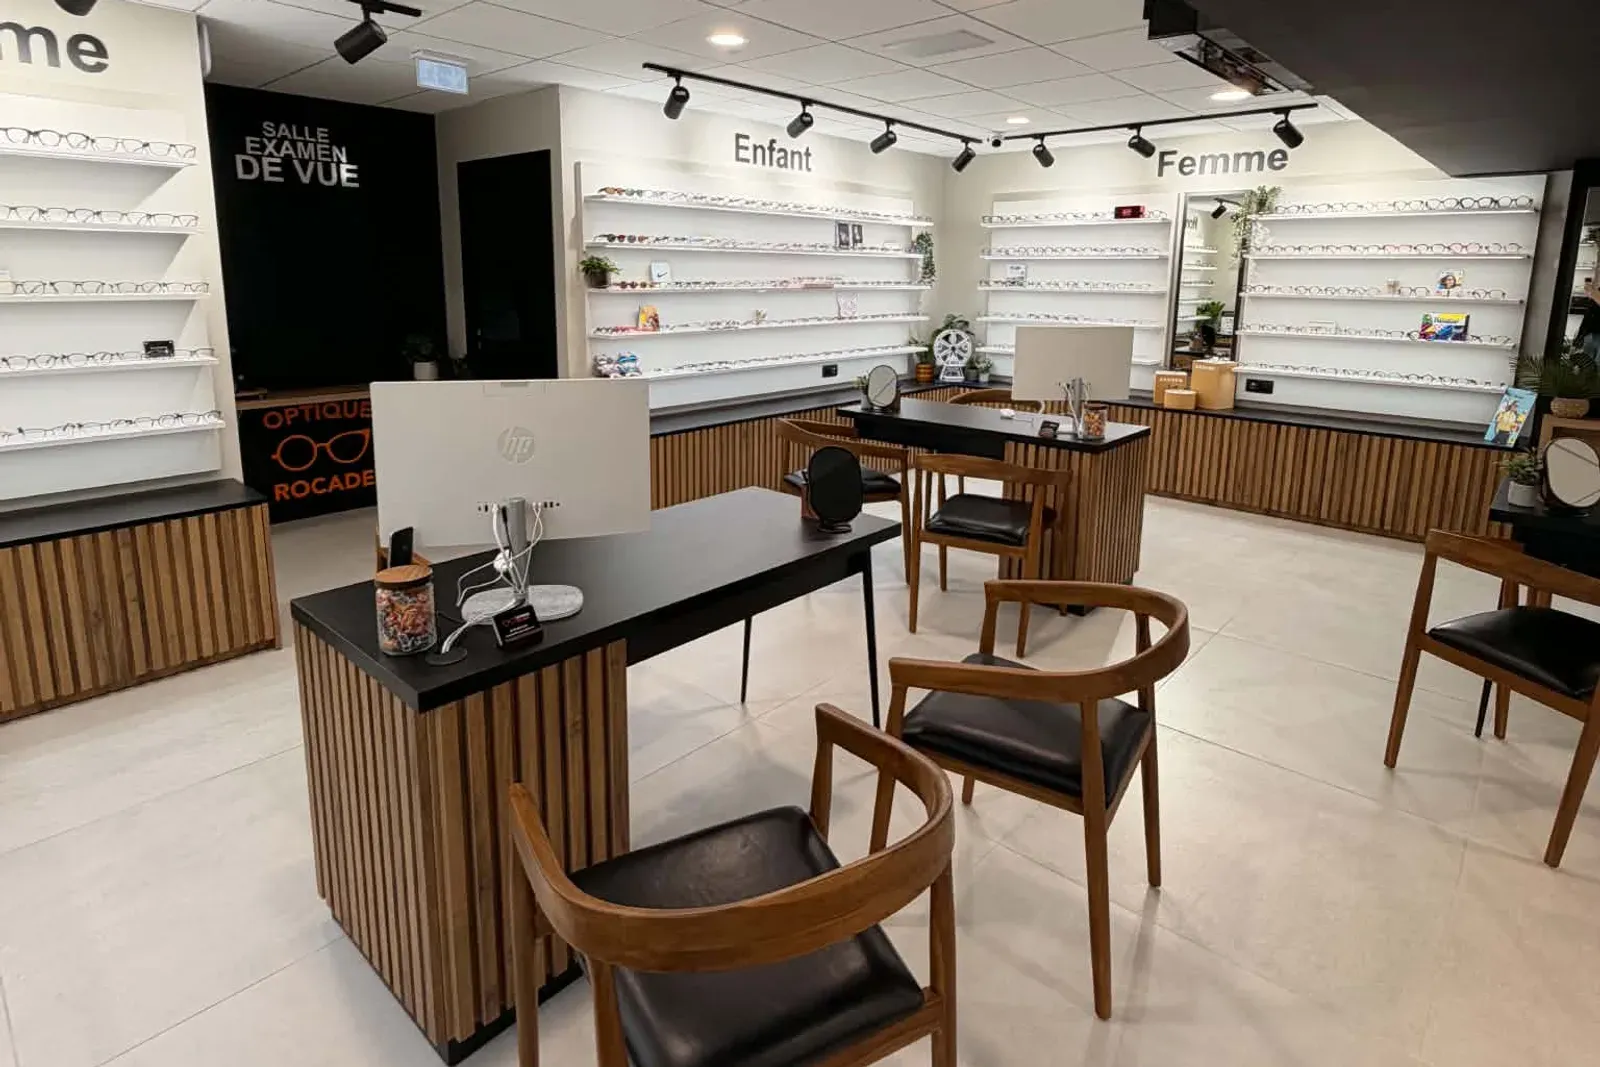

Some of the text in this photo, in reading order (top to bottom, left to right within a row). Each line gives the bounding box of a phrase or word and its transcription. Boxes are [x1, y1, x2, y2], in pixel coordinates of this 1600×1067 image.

[262, 121, 330, 143] SALLE
[245, 136, 347, 163] EXAMEN
[735, 132, 812, 172] Enfant
[1157, 148, 1289, 177] Femme
[235, 154, 360, 188] DE VUE
[262, 401, 372, 429] OPTIQUE
[500, 427, 535, 465] hp
[273, 469, 375, 501] ROCADE
